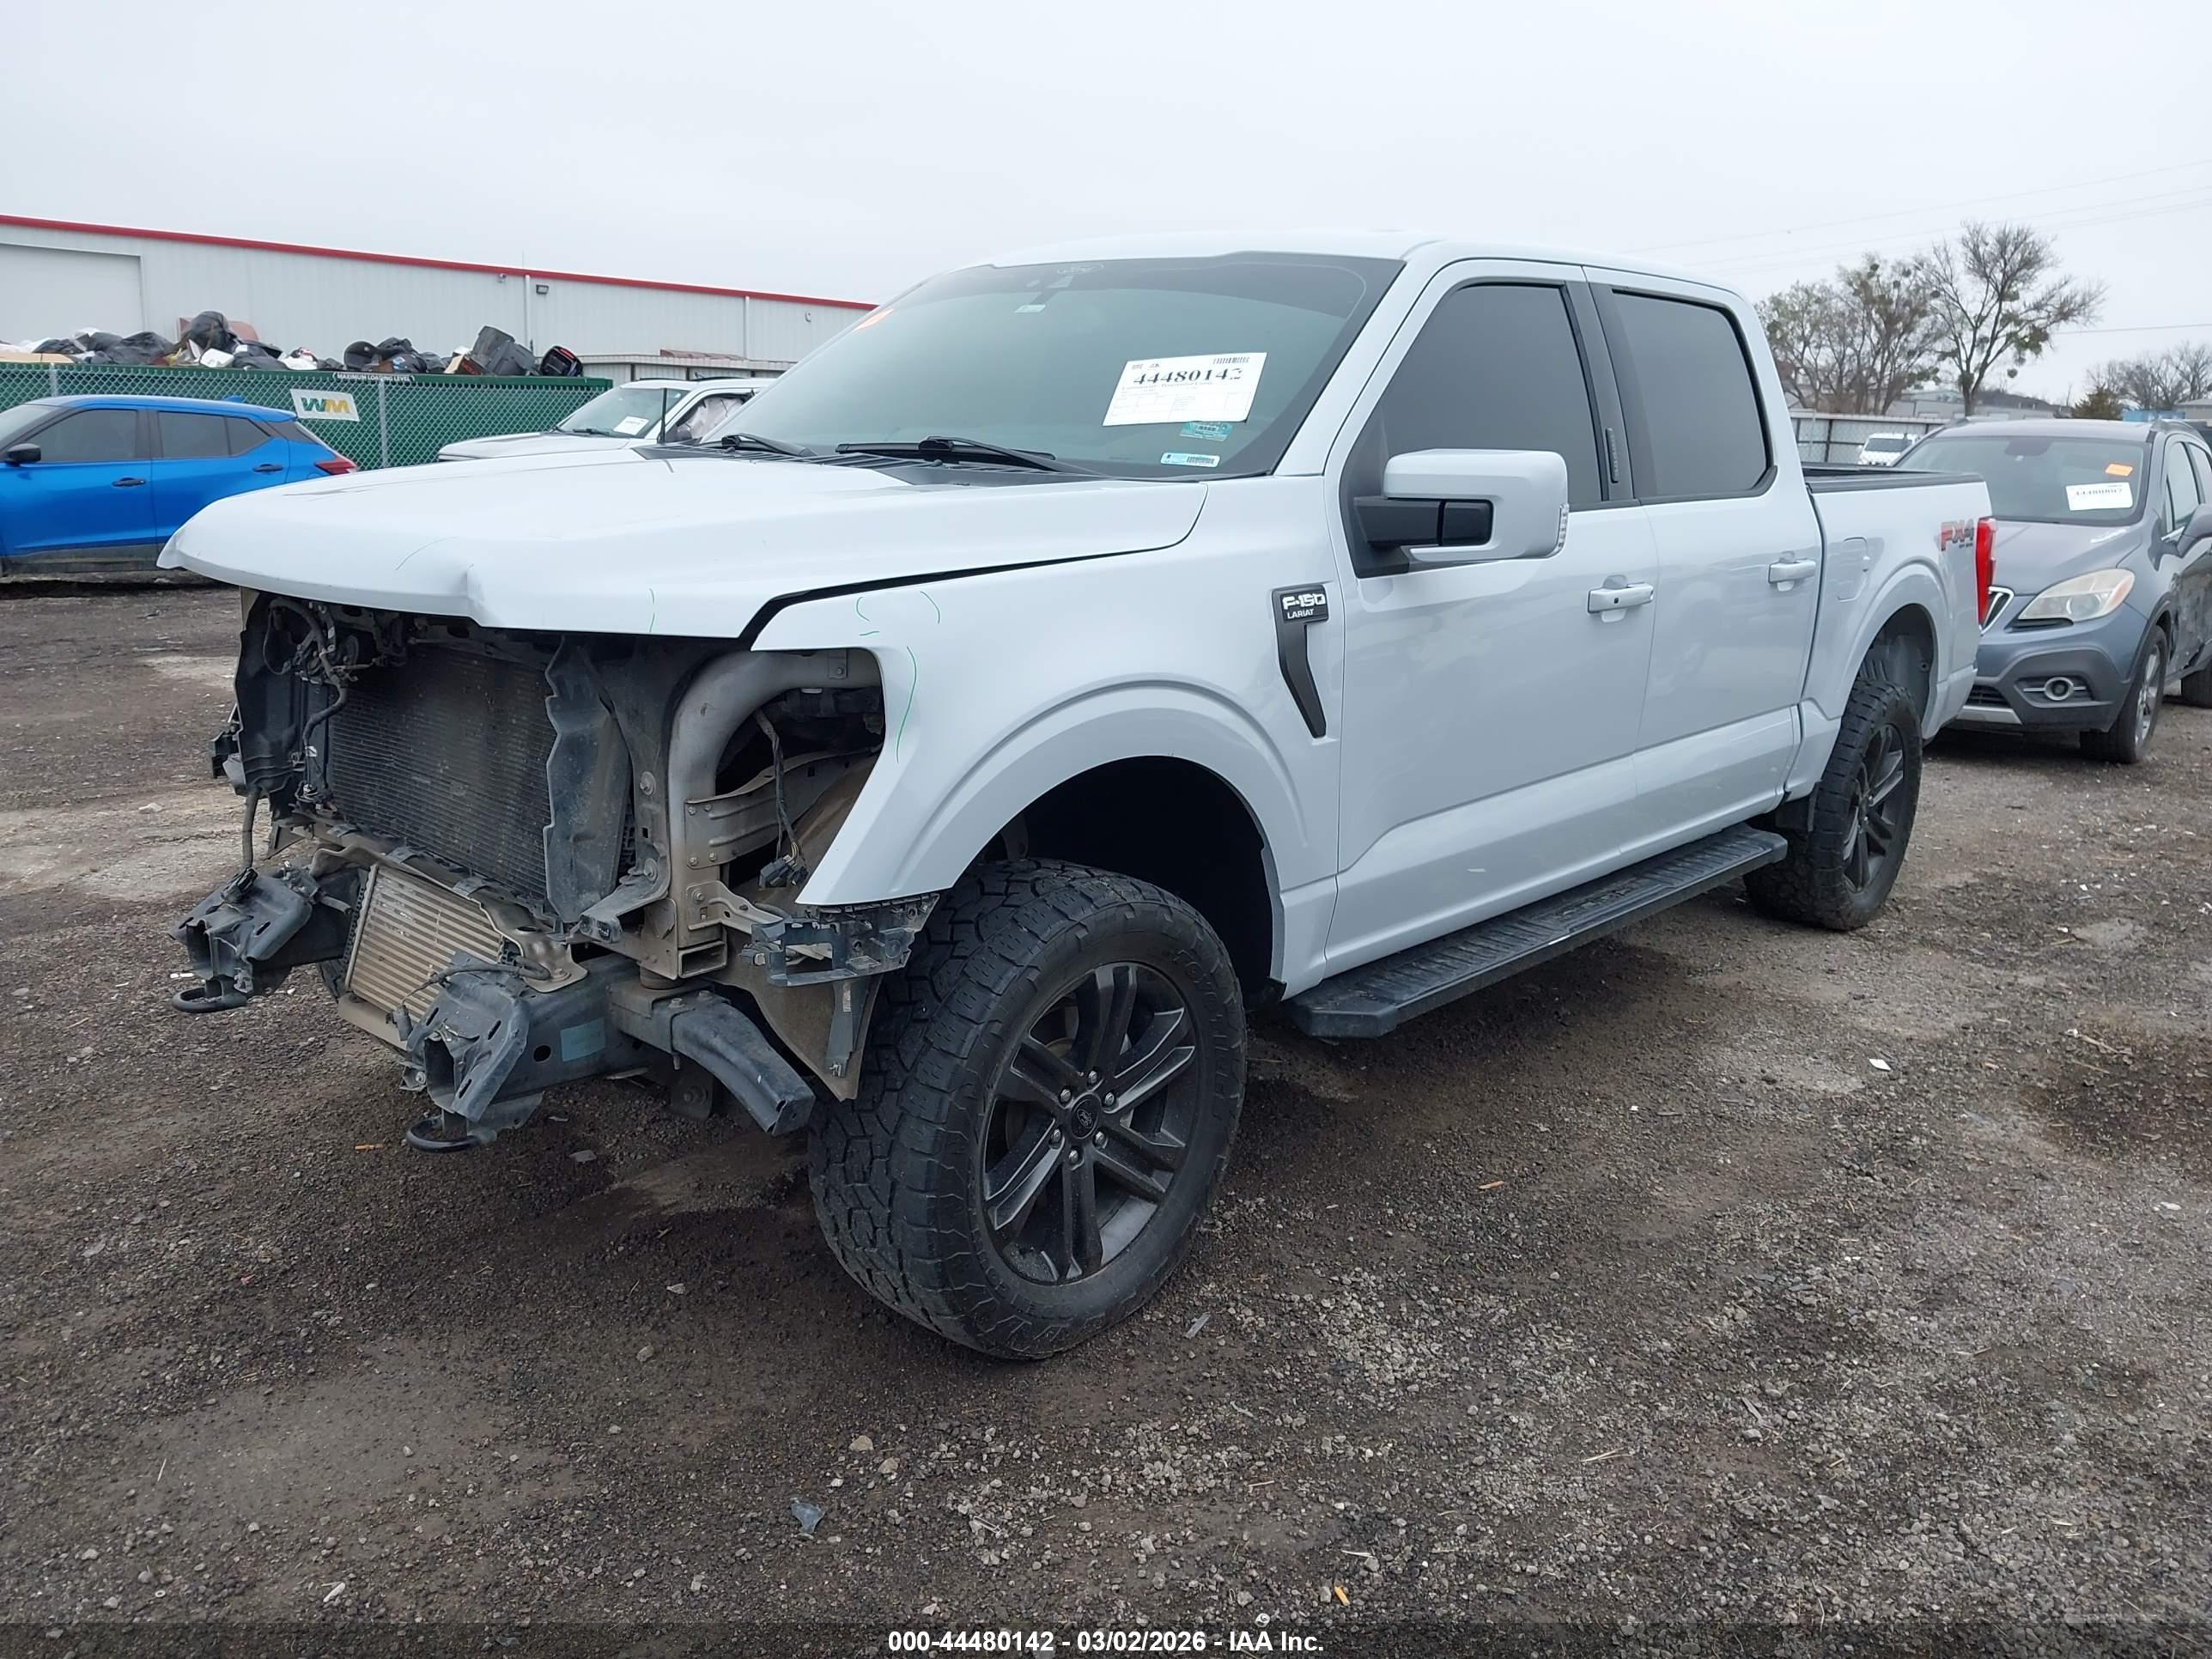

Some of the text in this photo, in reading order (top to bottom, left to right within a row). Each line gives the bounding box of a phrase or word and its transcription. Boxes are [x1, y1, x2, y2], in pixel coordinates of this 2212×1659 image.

[1133, 368, 1243, 385] 44480142
[301, 398, 349, 412] WM
[1941, 519, 1974, 551] FX4
[1282, 593, 1326, 610] F-150
[1287, 609, 1314, 619] LARIAT
